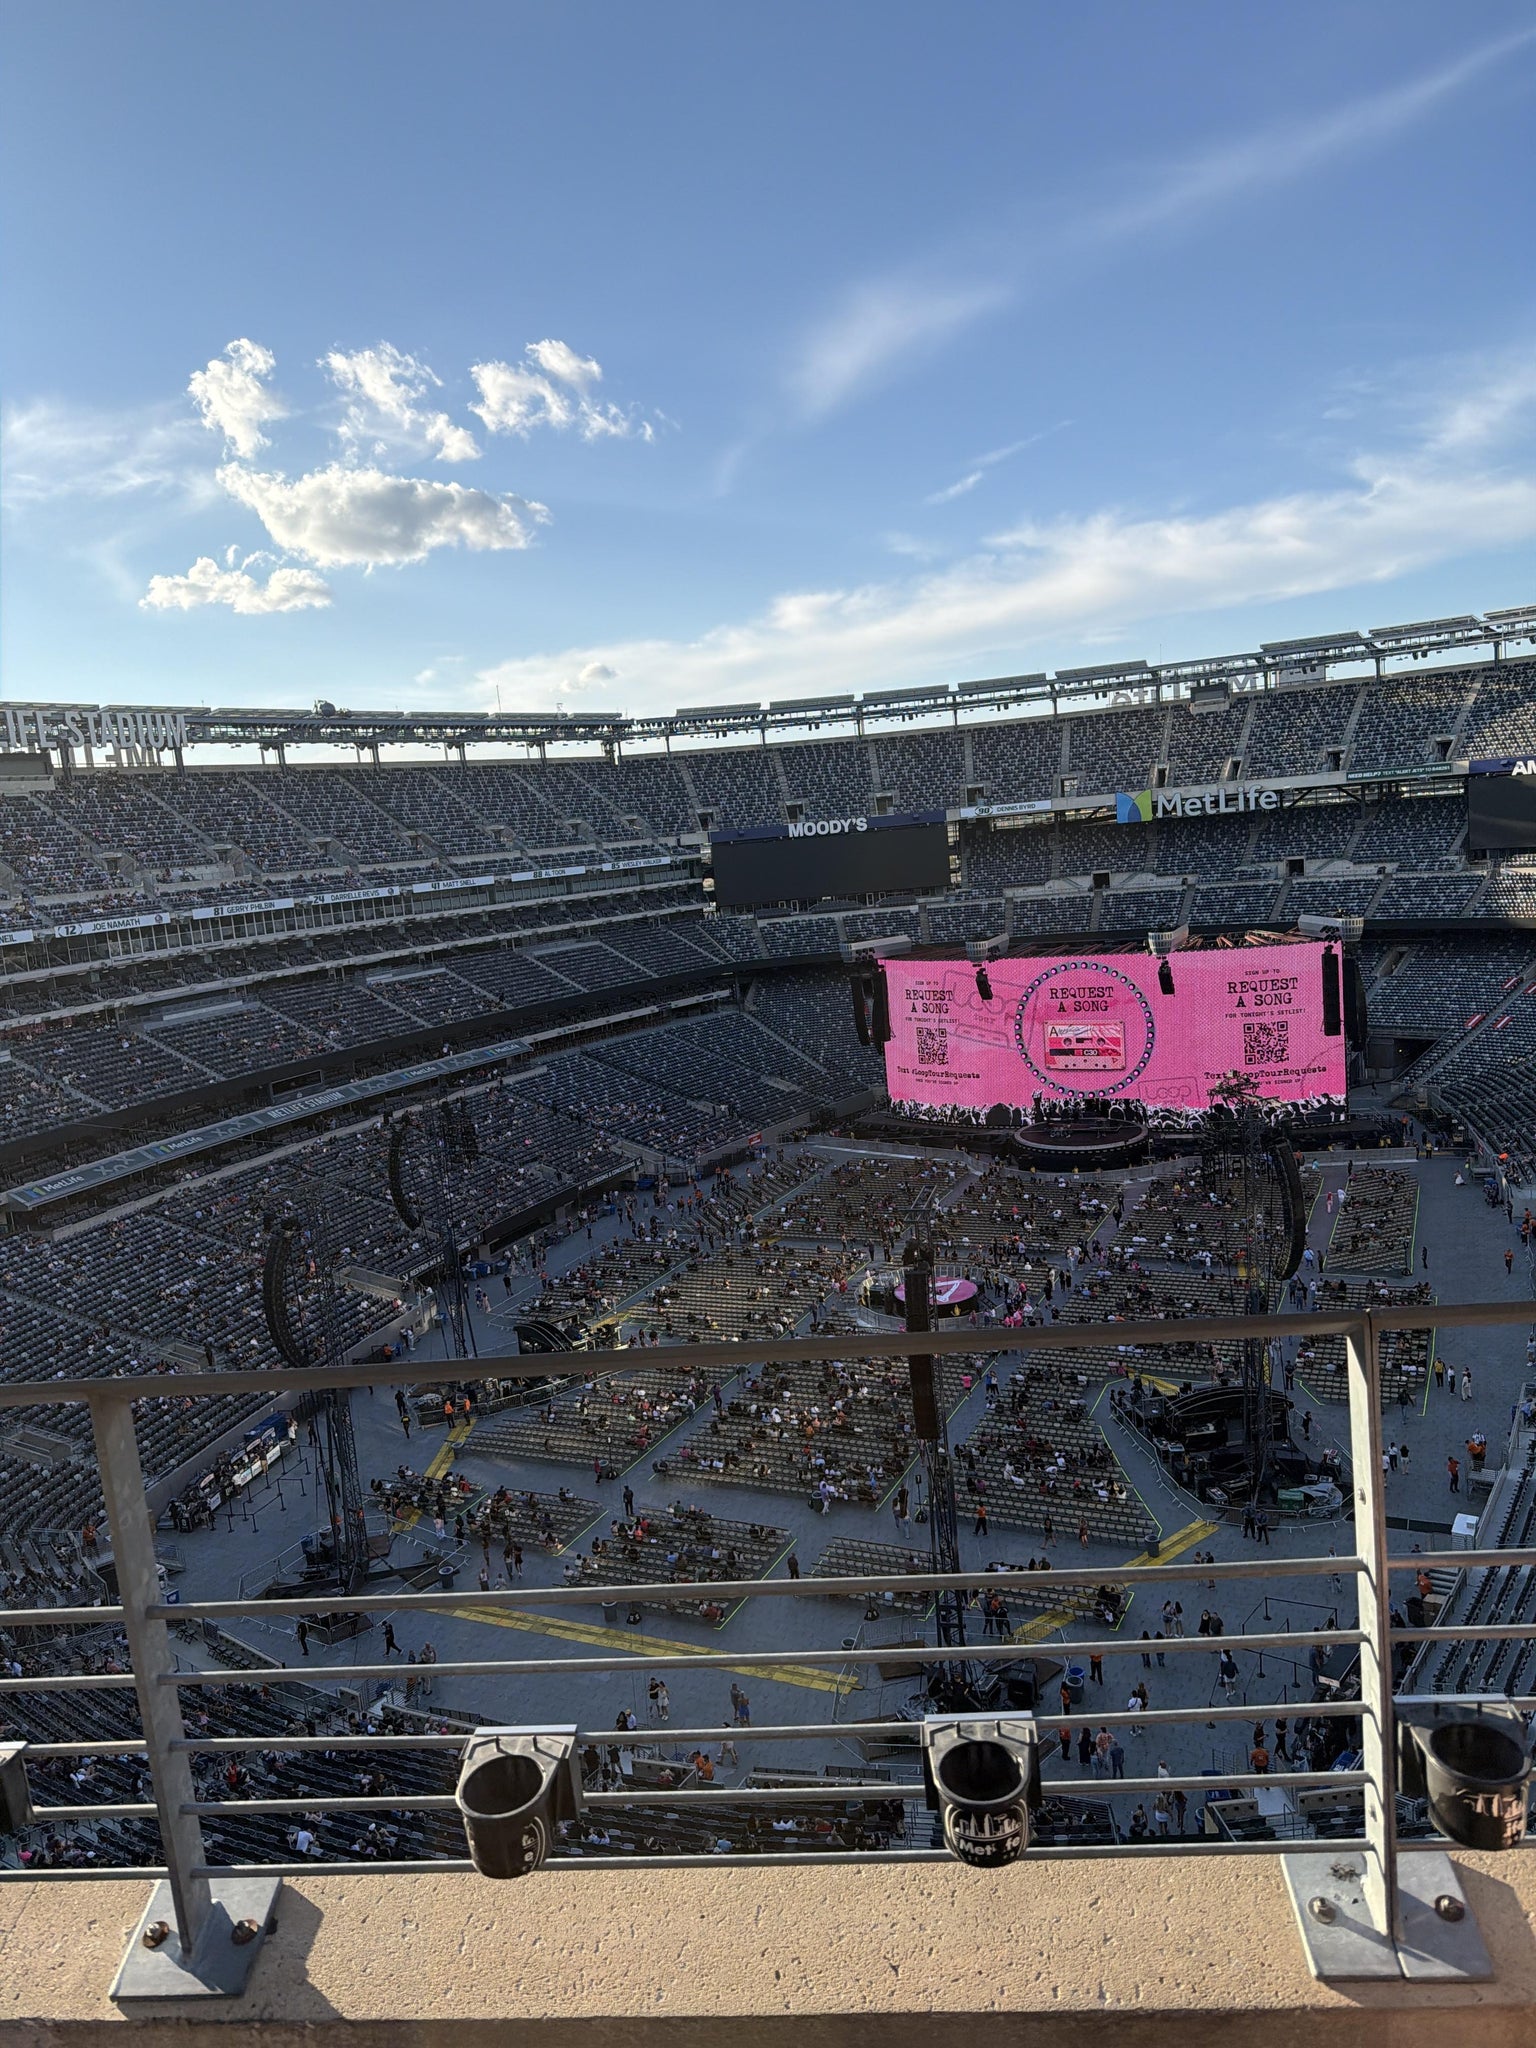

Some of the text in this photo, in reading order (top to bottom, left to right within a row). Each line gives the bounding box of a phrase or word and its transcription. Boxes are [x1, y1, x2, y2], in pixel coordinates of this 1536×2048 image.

[0, 710, 188, 748] IFE STADIUM
[1156, 784, 1278, 818] MetLife
[788, 817, 868, 838] MOODY'S
[443, 880, 459, 888] MATT
[313, 890, 380, 904] 24 DARRELLE REVIS
[214, 902, 275, 916] 81 GERRY PHILBIN
[64, 918, 141, 935] 12 JOE NAMATH
[1227, 977, 1298, 994] REQUEST
[905, 989, 953, 1002] REQUEST
[1049, 986, 1114, 1000] REQUEST
[1236, 992, 1293, 1008] A SONG
[911, 1002, 950, 1014] A SONG
[1057, 1000, 1109, 1012] A SONG
[1240, 1010, 1274, 1018] TONIGHT'S
[1050, 1026, 1058, 1036] A
[1204, 1072, 1227, 1080] Text
[267, 1092, 345, 1119] METLIFE STADIUM
[168, 1135, 204, 1150] MetLife
[42, 1175, 85, 1192] MetLife
